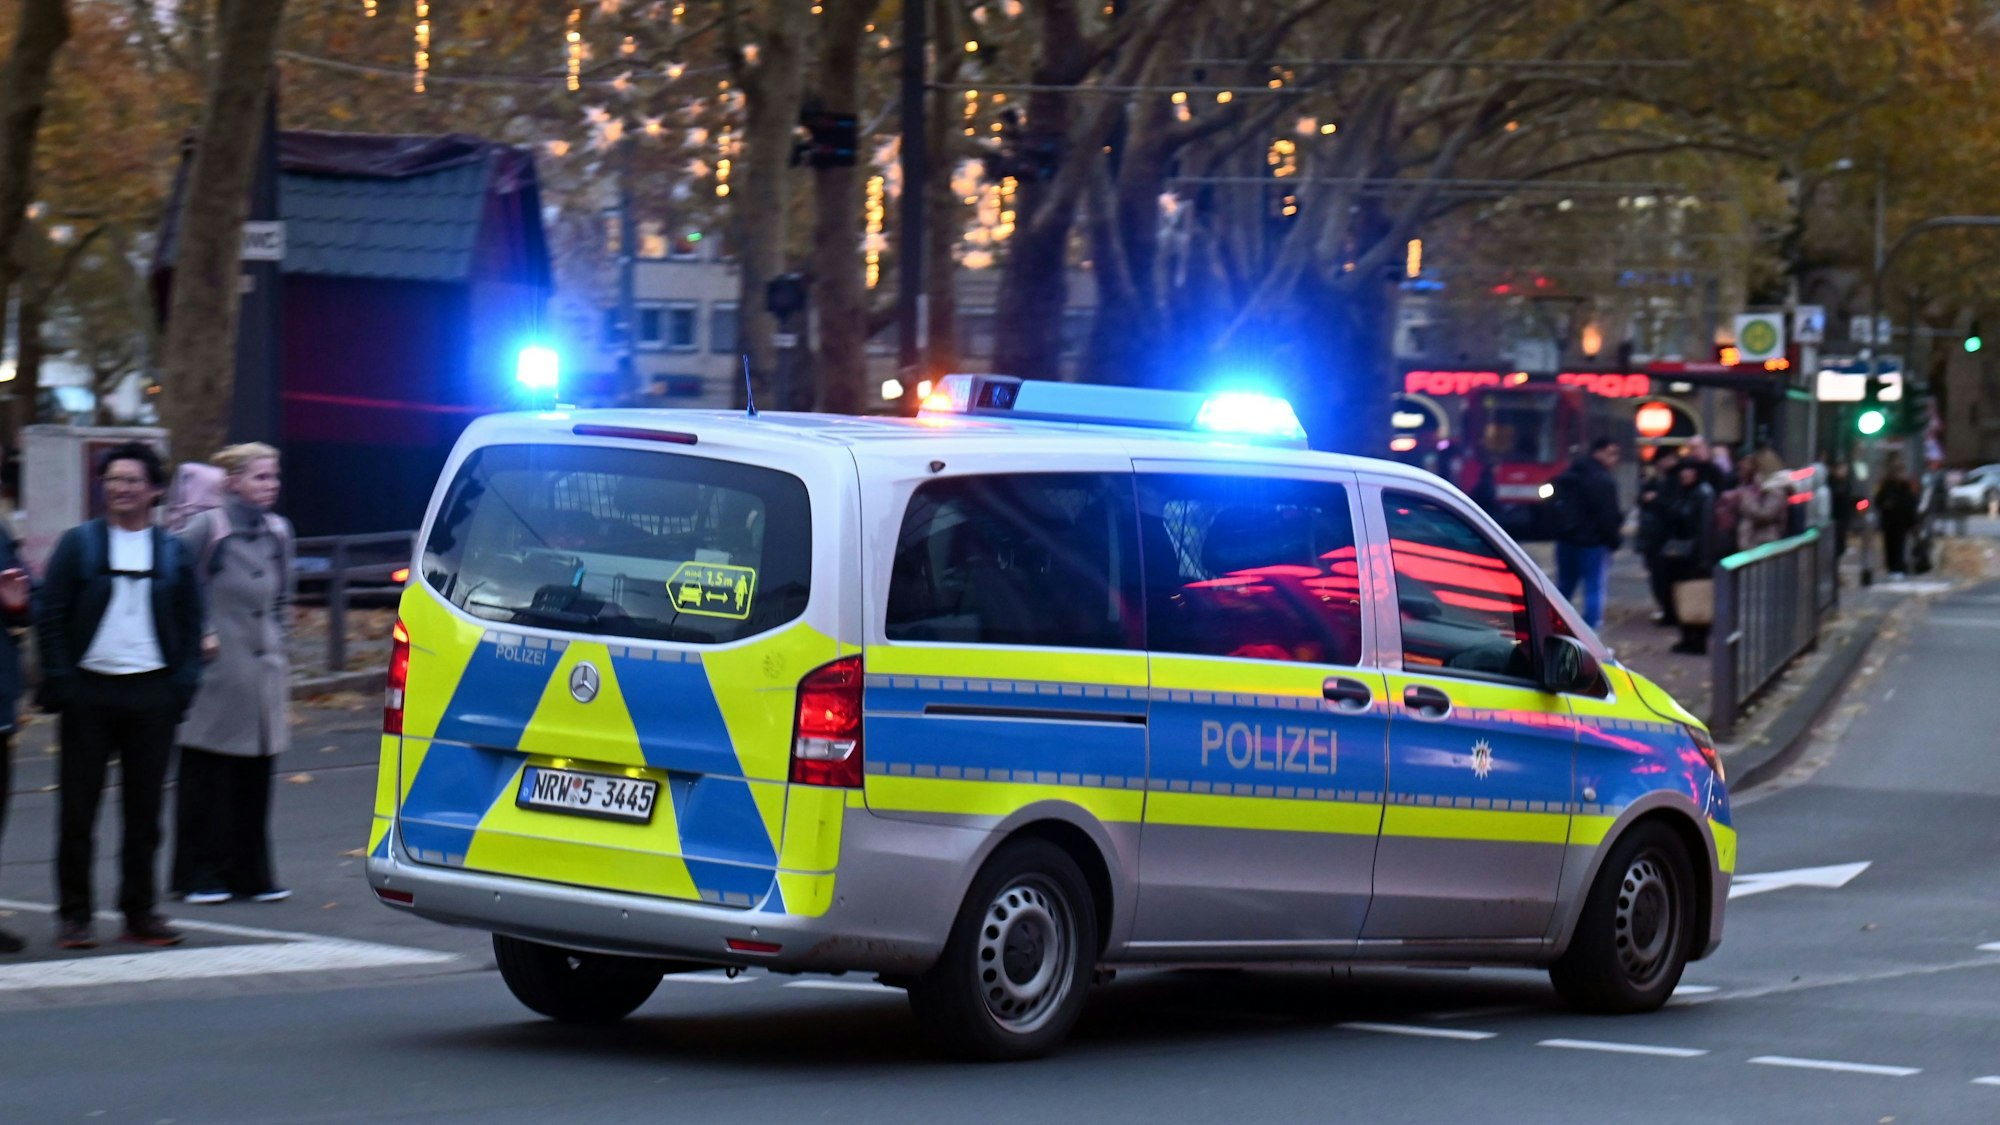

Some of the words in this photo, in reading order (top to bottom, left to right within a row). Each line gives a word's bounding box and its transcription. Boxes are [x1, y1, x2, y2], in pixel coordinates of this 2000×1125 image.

[495, 645, 546, 666] POLIZEI
[1201, 720, 1337, 775] POLIZEI
[532, 772, 573, 803] NRW
[580, 778, 653, 812] 5-3445
